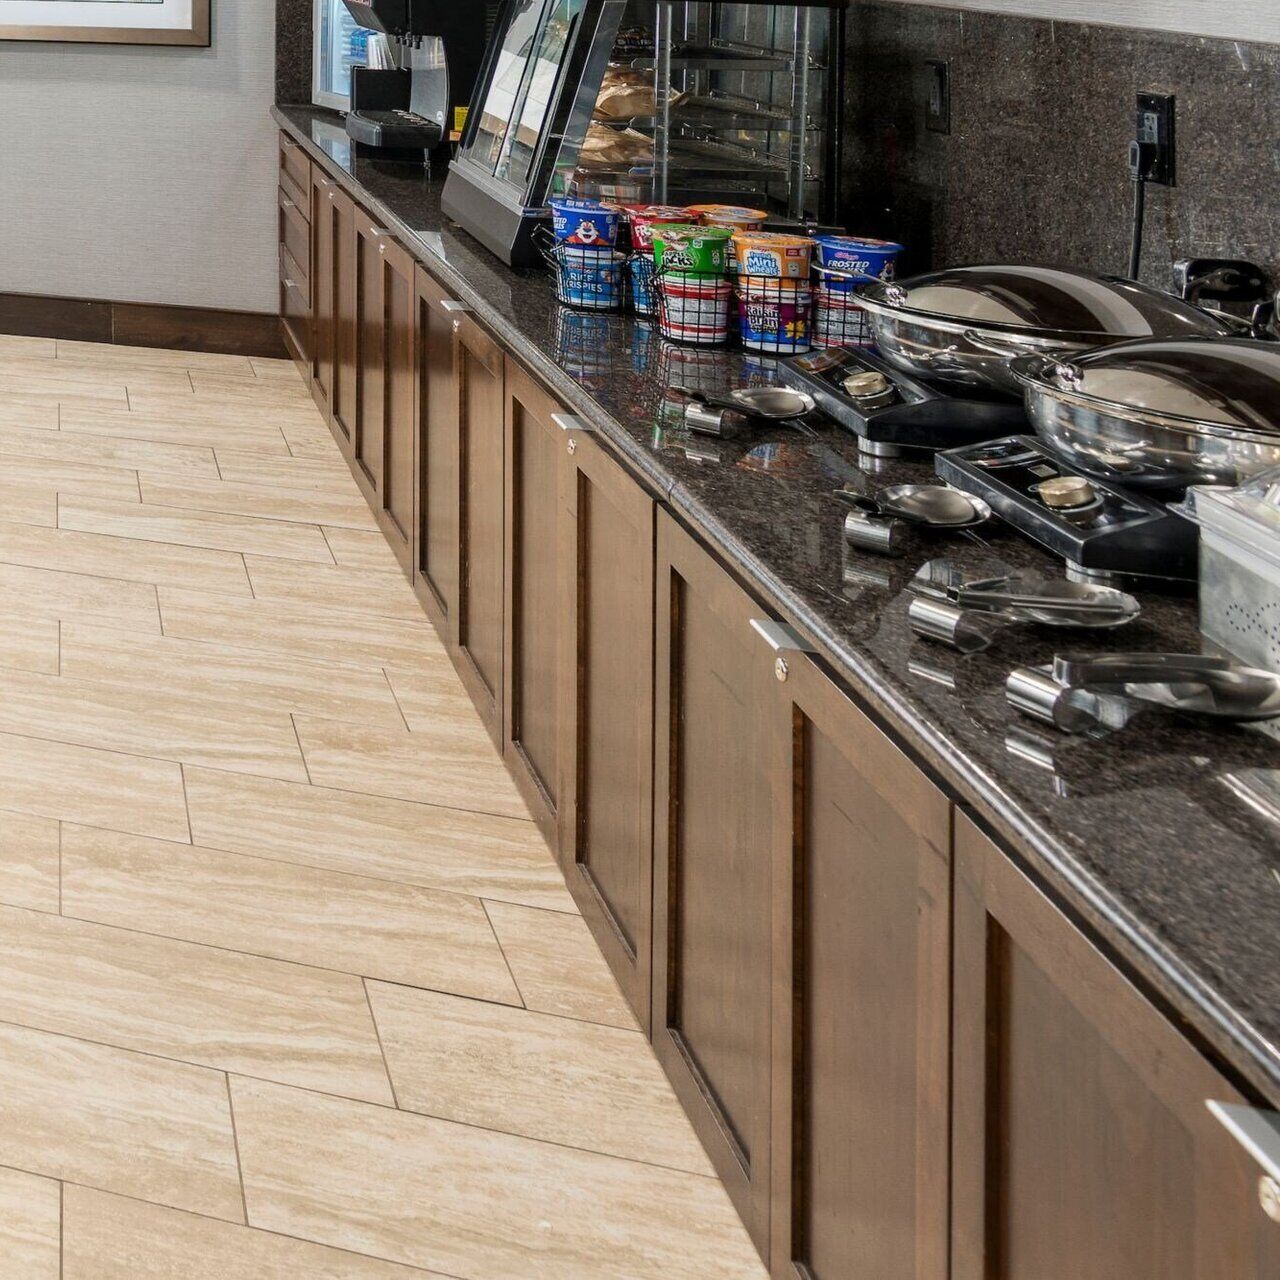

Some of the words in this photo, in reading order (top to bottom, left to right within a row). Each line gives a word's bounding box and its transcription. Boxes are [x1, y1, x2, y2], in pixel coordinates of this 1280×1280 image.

[748, 257, 776, 268] Mini
[827, 259, 870, 269] FROSTED
[570, 272, 594, 282] RICE
